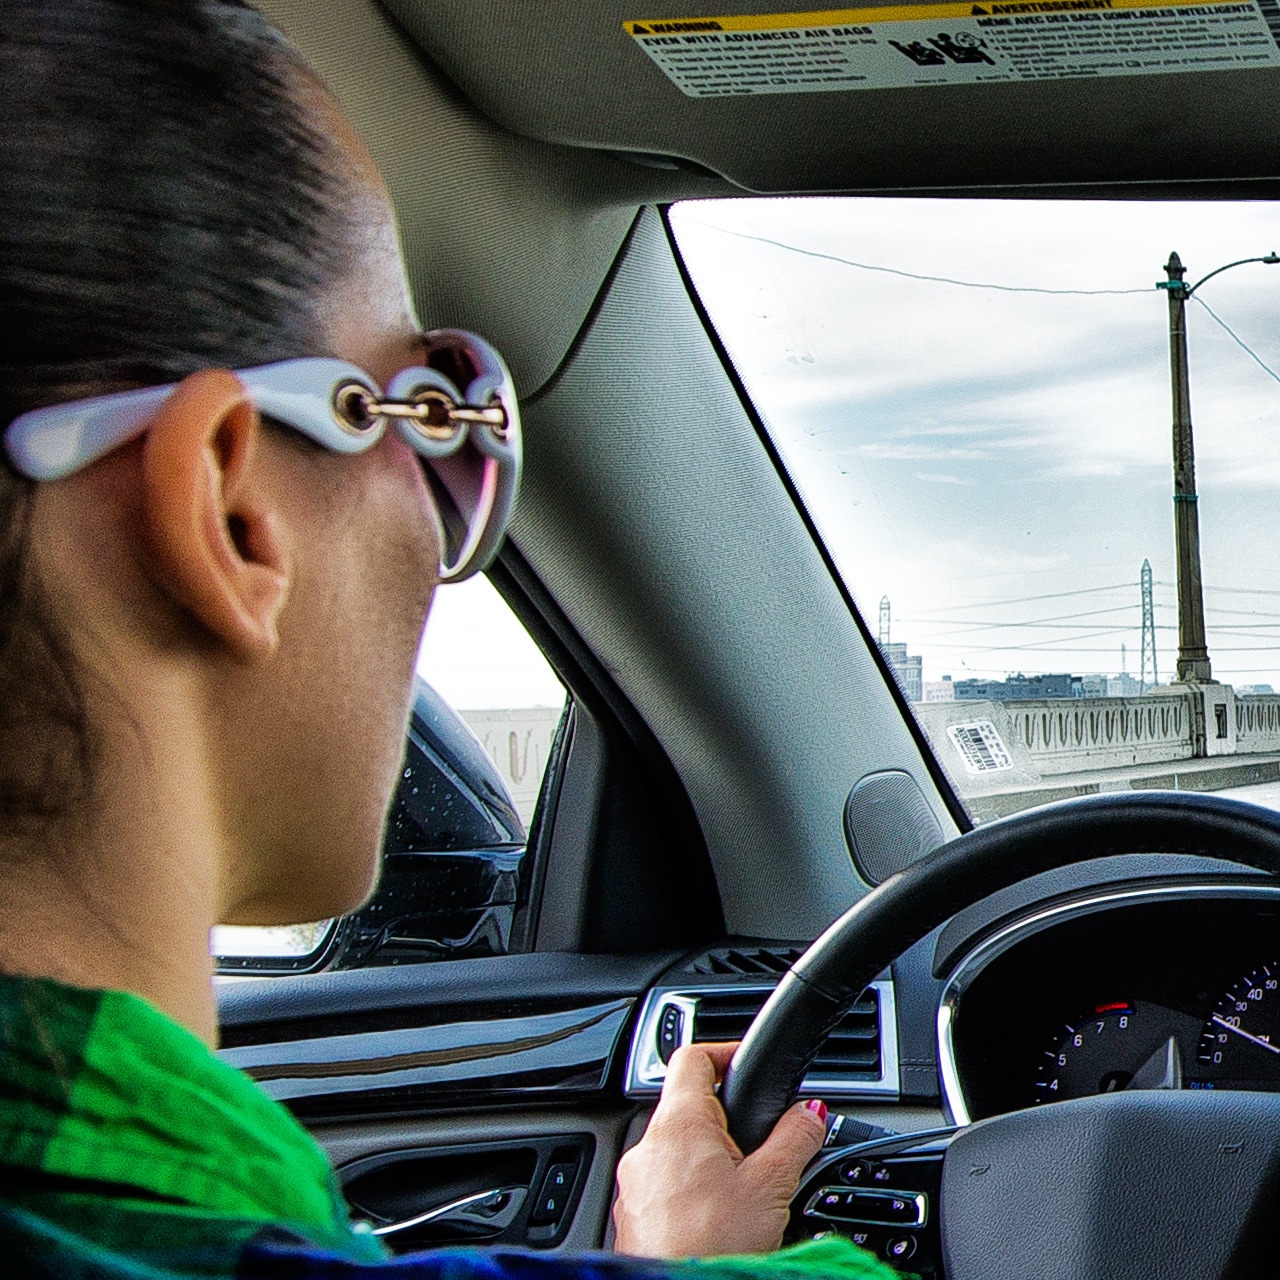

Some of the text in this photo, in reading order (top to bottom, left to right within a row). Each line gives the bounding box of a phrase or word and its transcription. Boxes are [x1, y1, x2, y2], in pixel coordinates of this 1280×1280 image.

[992, 0, 1112, 14] AVERTISSEMENT
[1014, 15, 1044, 25] AVEC
[1045, 14, 1069, 23] DES
[1070, 13, 1102, 21] SACS
[649, 21, 723, 33] WARNING
[642, 26, 873, 45] EVEN WITH ADVANCED AIR BAGS
[1265, 979, 1277, 990] 50
[1247, 988, 1263, 1000] 40
[1236, 1001, 1247, 1012] 30
[1096, 1022, 1105, 1034] 7
[1119, 1016, 1128, 1028] 8
[1226, 1016, 1240, 1029] 20
[1073, 1034, 1083, 1047] 6
[1217, 1033, 1228, 1043] 10
[1058, 1054, 1067, 1066] 5
[1213, 1052, 1222, 1064] 0
[1050, 1079, 1059, 1090] 4
